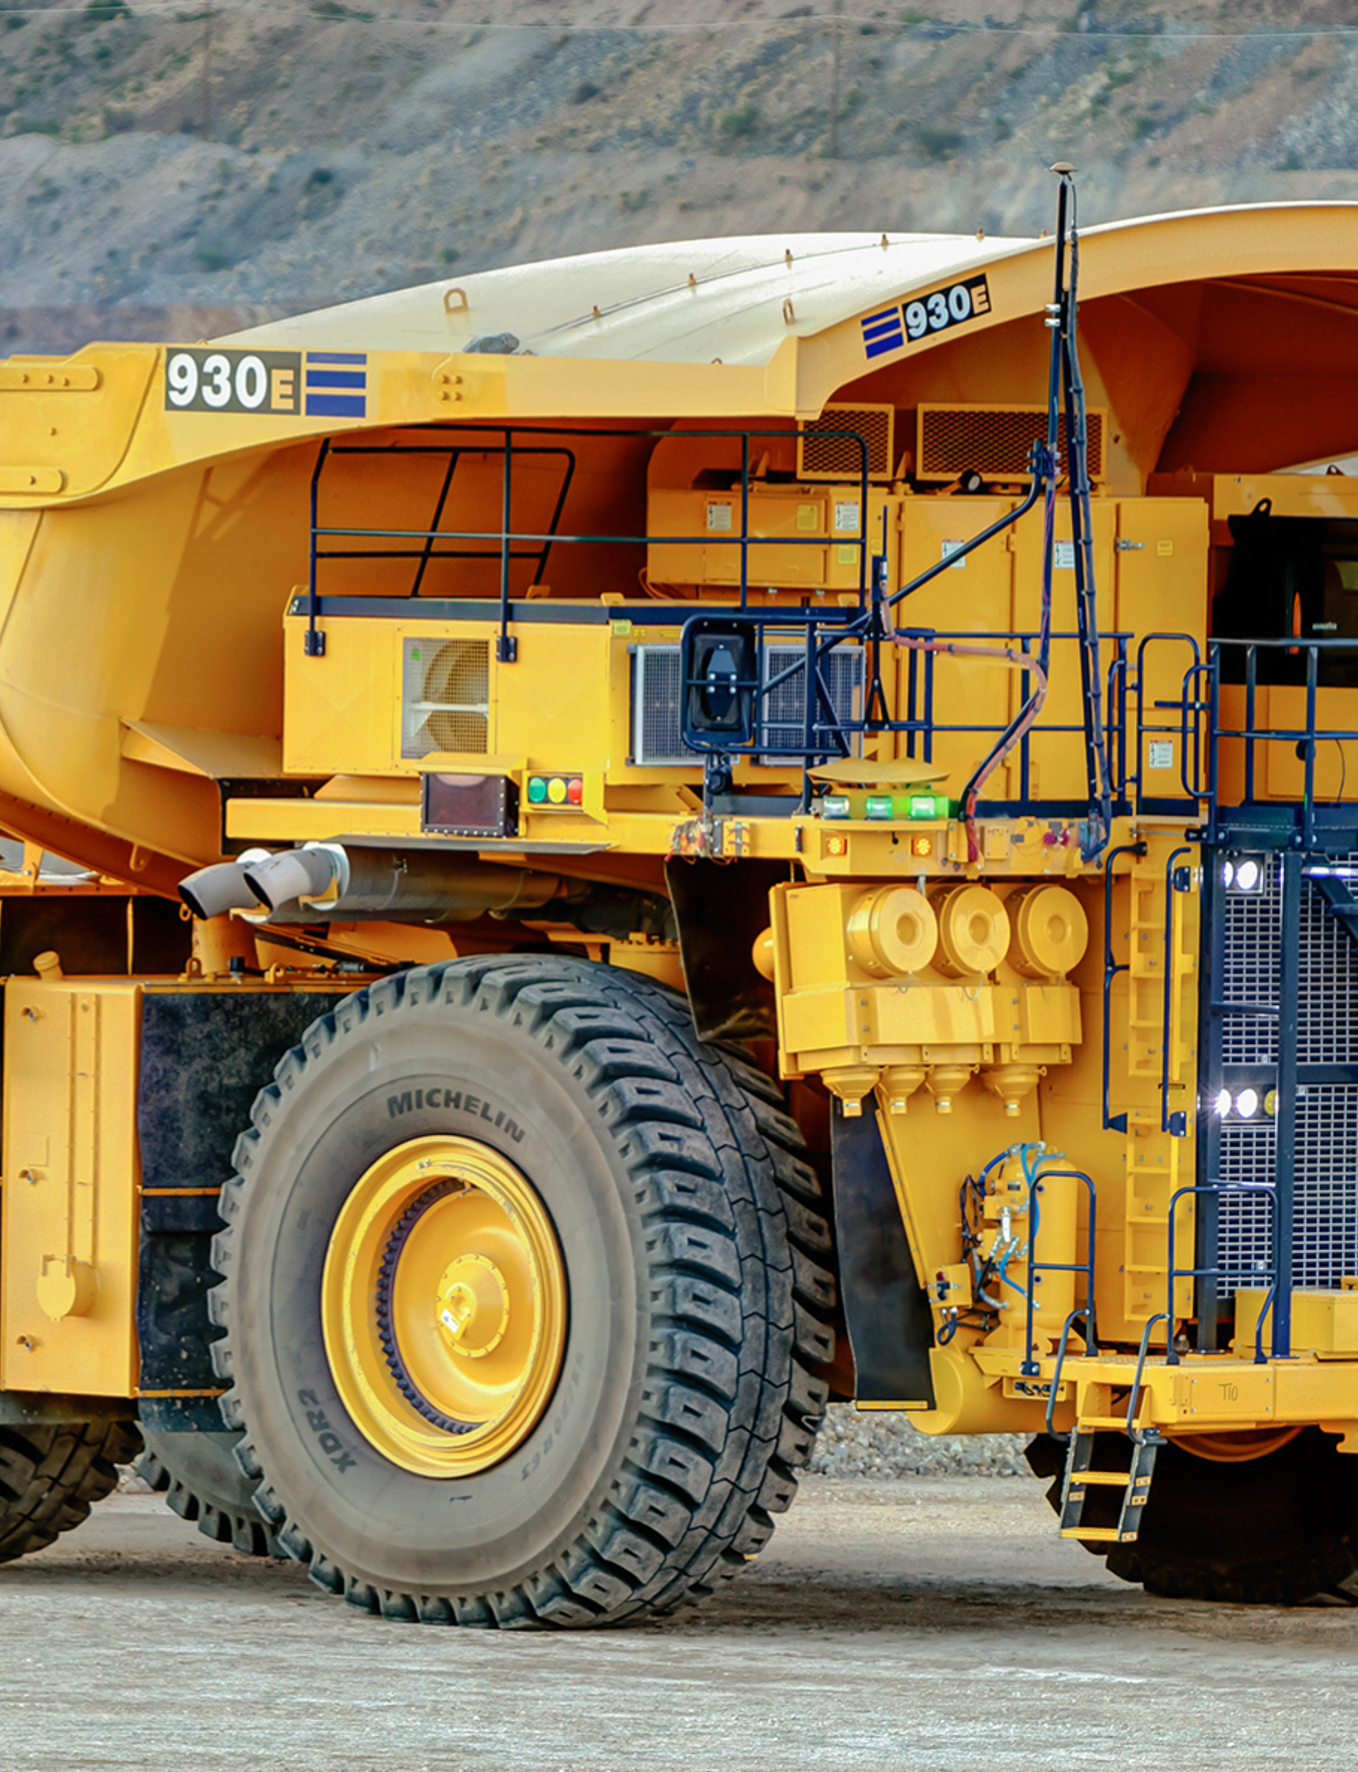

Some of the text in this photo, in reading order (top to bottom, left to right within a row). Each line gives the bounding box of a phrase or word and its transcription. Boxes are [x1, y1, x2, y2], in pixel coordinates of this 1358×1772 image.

[905, 285, 989, 338] 930E
[168, 353, 294, 409] 930E
[387, 1088, 526, 1143] MICHELIN
[297, 1388, 358, 1474] XDR2
